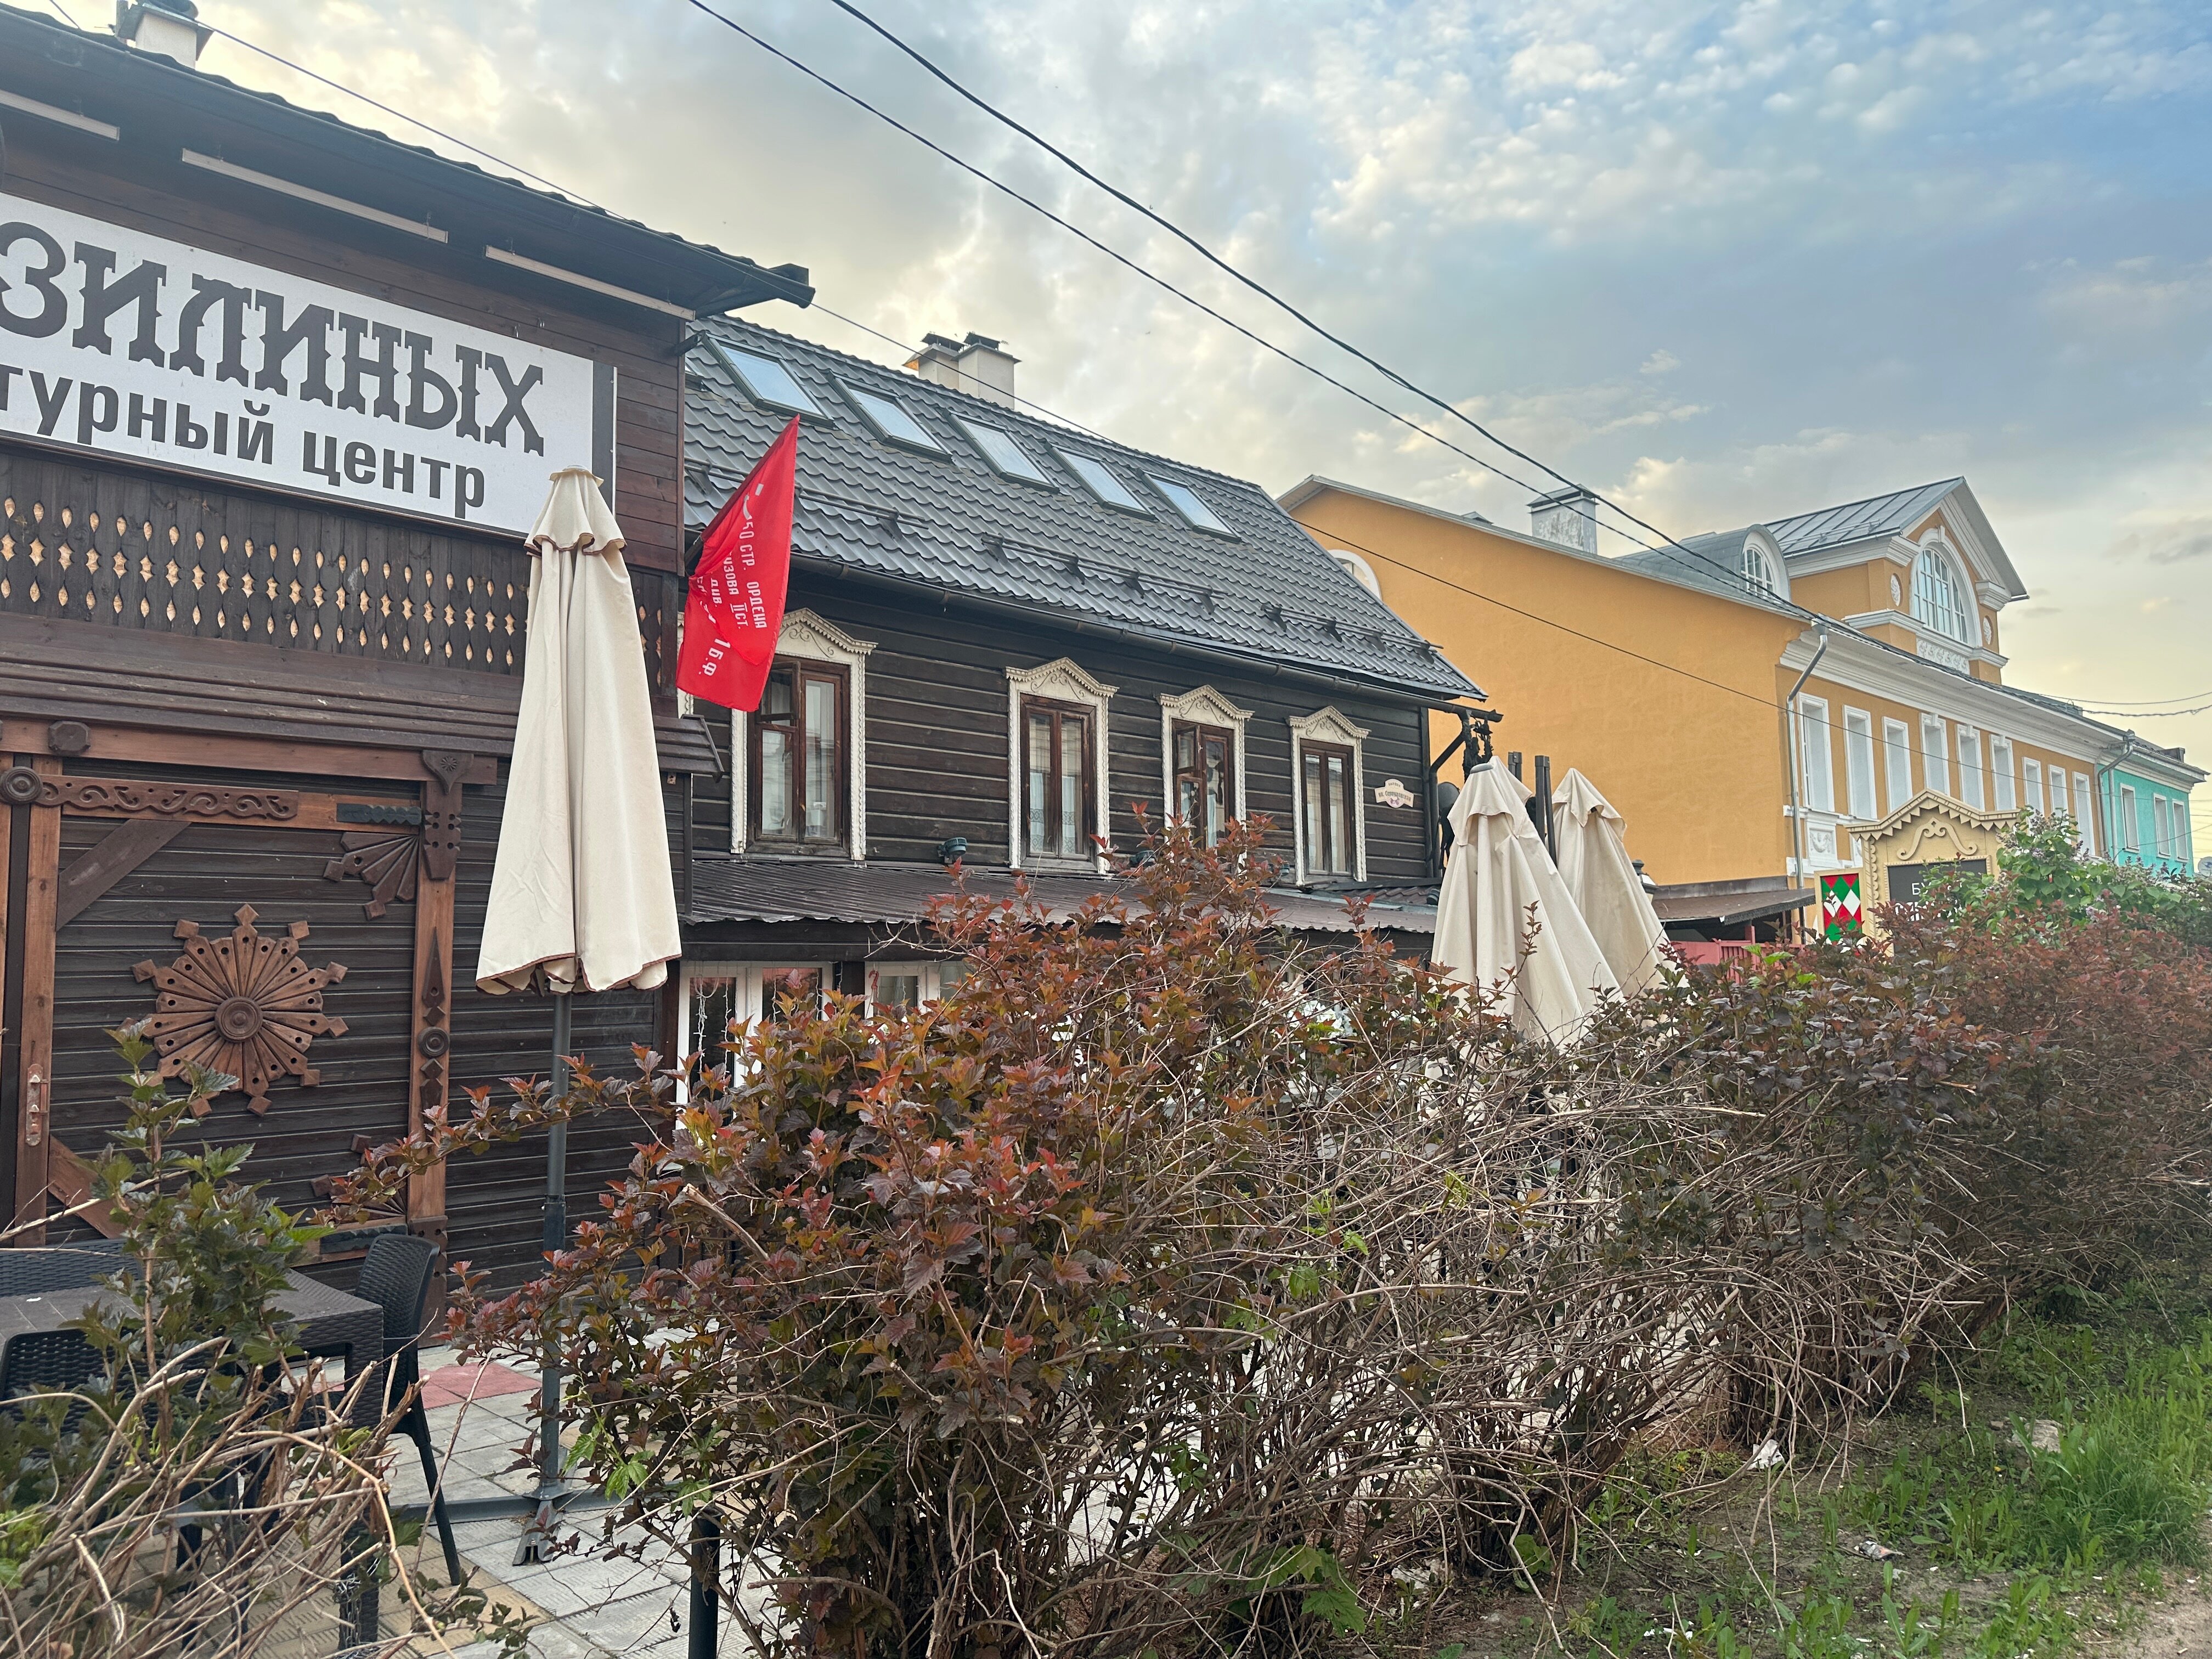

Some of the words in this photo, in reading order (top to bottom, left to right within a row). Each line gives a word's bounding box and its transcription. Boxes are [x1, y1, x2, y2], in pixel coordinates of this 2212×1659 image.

[0, 222, 544, 457] ЗИЛИНЫХ
[303, 431, 484, 520] центр
[740, 544, 755, 571] СТР.
[746, 581, 768, 628] ОРДЕНА
